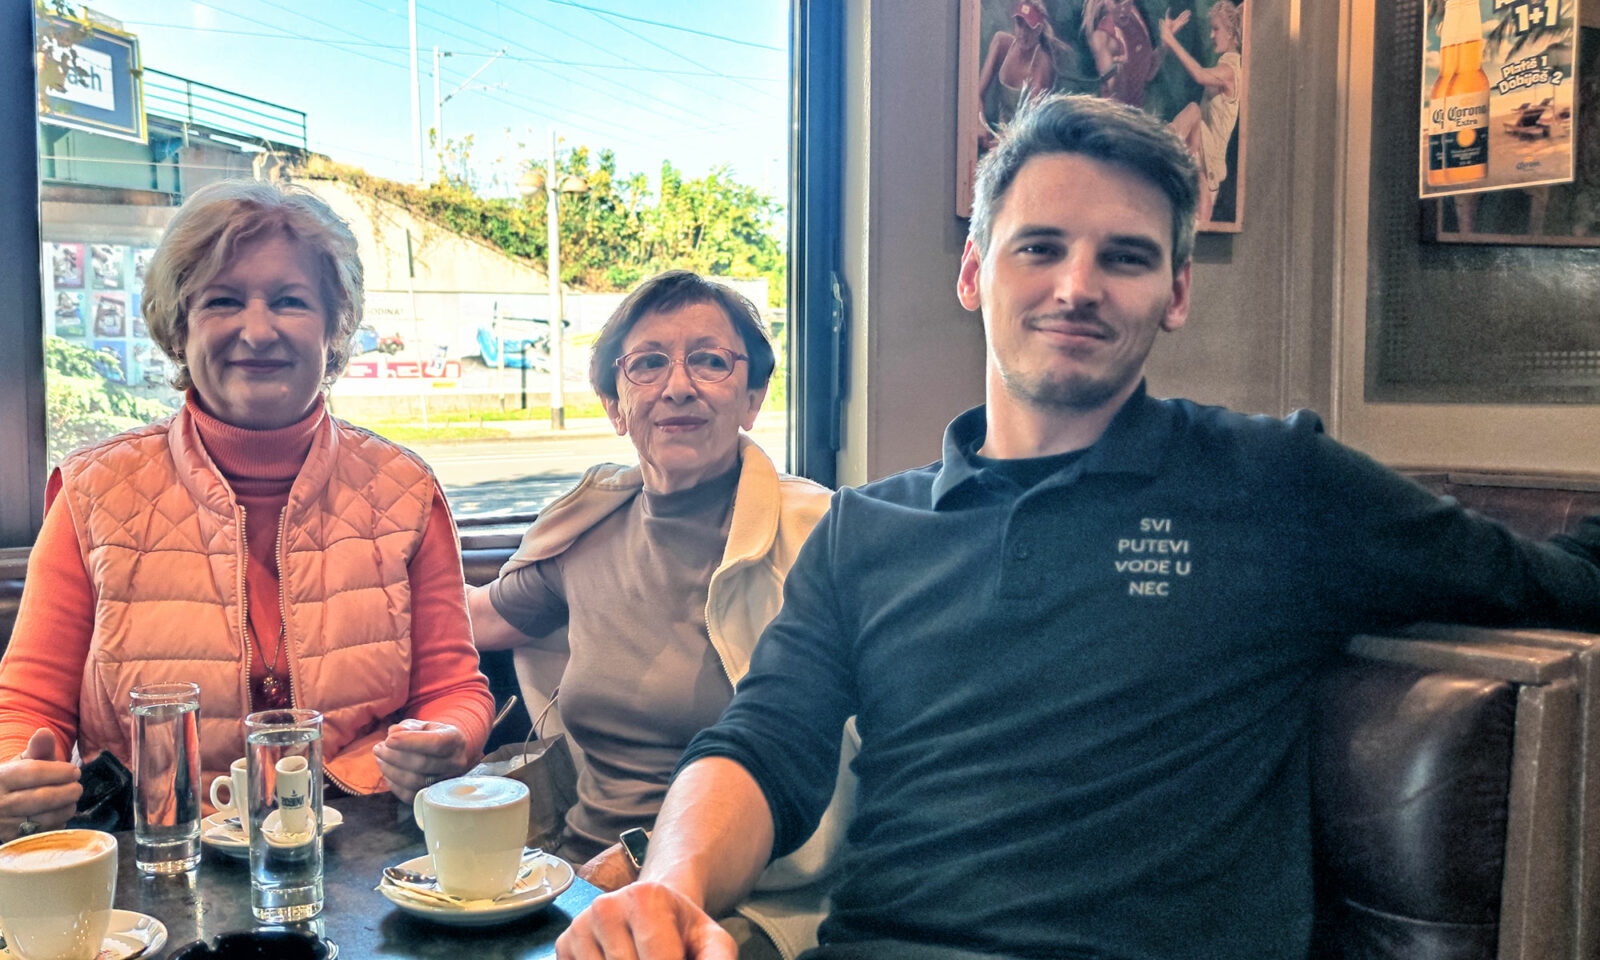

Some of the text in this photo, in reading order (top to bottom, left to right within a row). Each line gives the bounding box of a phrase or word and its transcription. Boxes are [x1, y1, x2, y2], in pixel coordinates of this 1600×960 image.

[1515, 0, 1558, 32] 1+1
[1541, 55, 1548, 67] 1
[1551, 71, 1563, 84] 2
[1447, 105, 1487, 121] Corona
[1456, 118, 1478, 127] Extra
[1140, 517, 1170, 532] SVI
[1117, 539, 1189, 553] PUTEVI
[1115, 559, 1191, 575] VODE U
[1128, 581, 1169, 596] NEC
